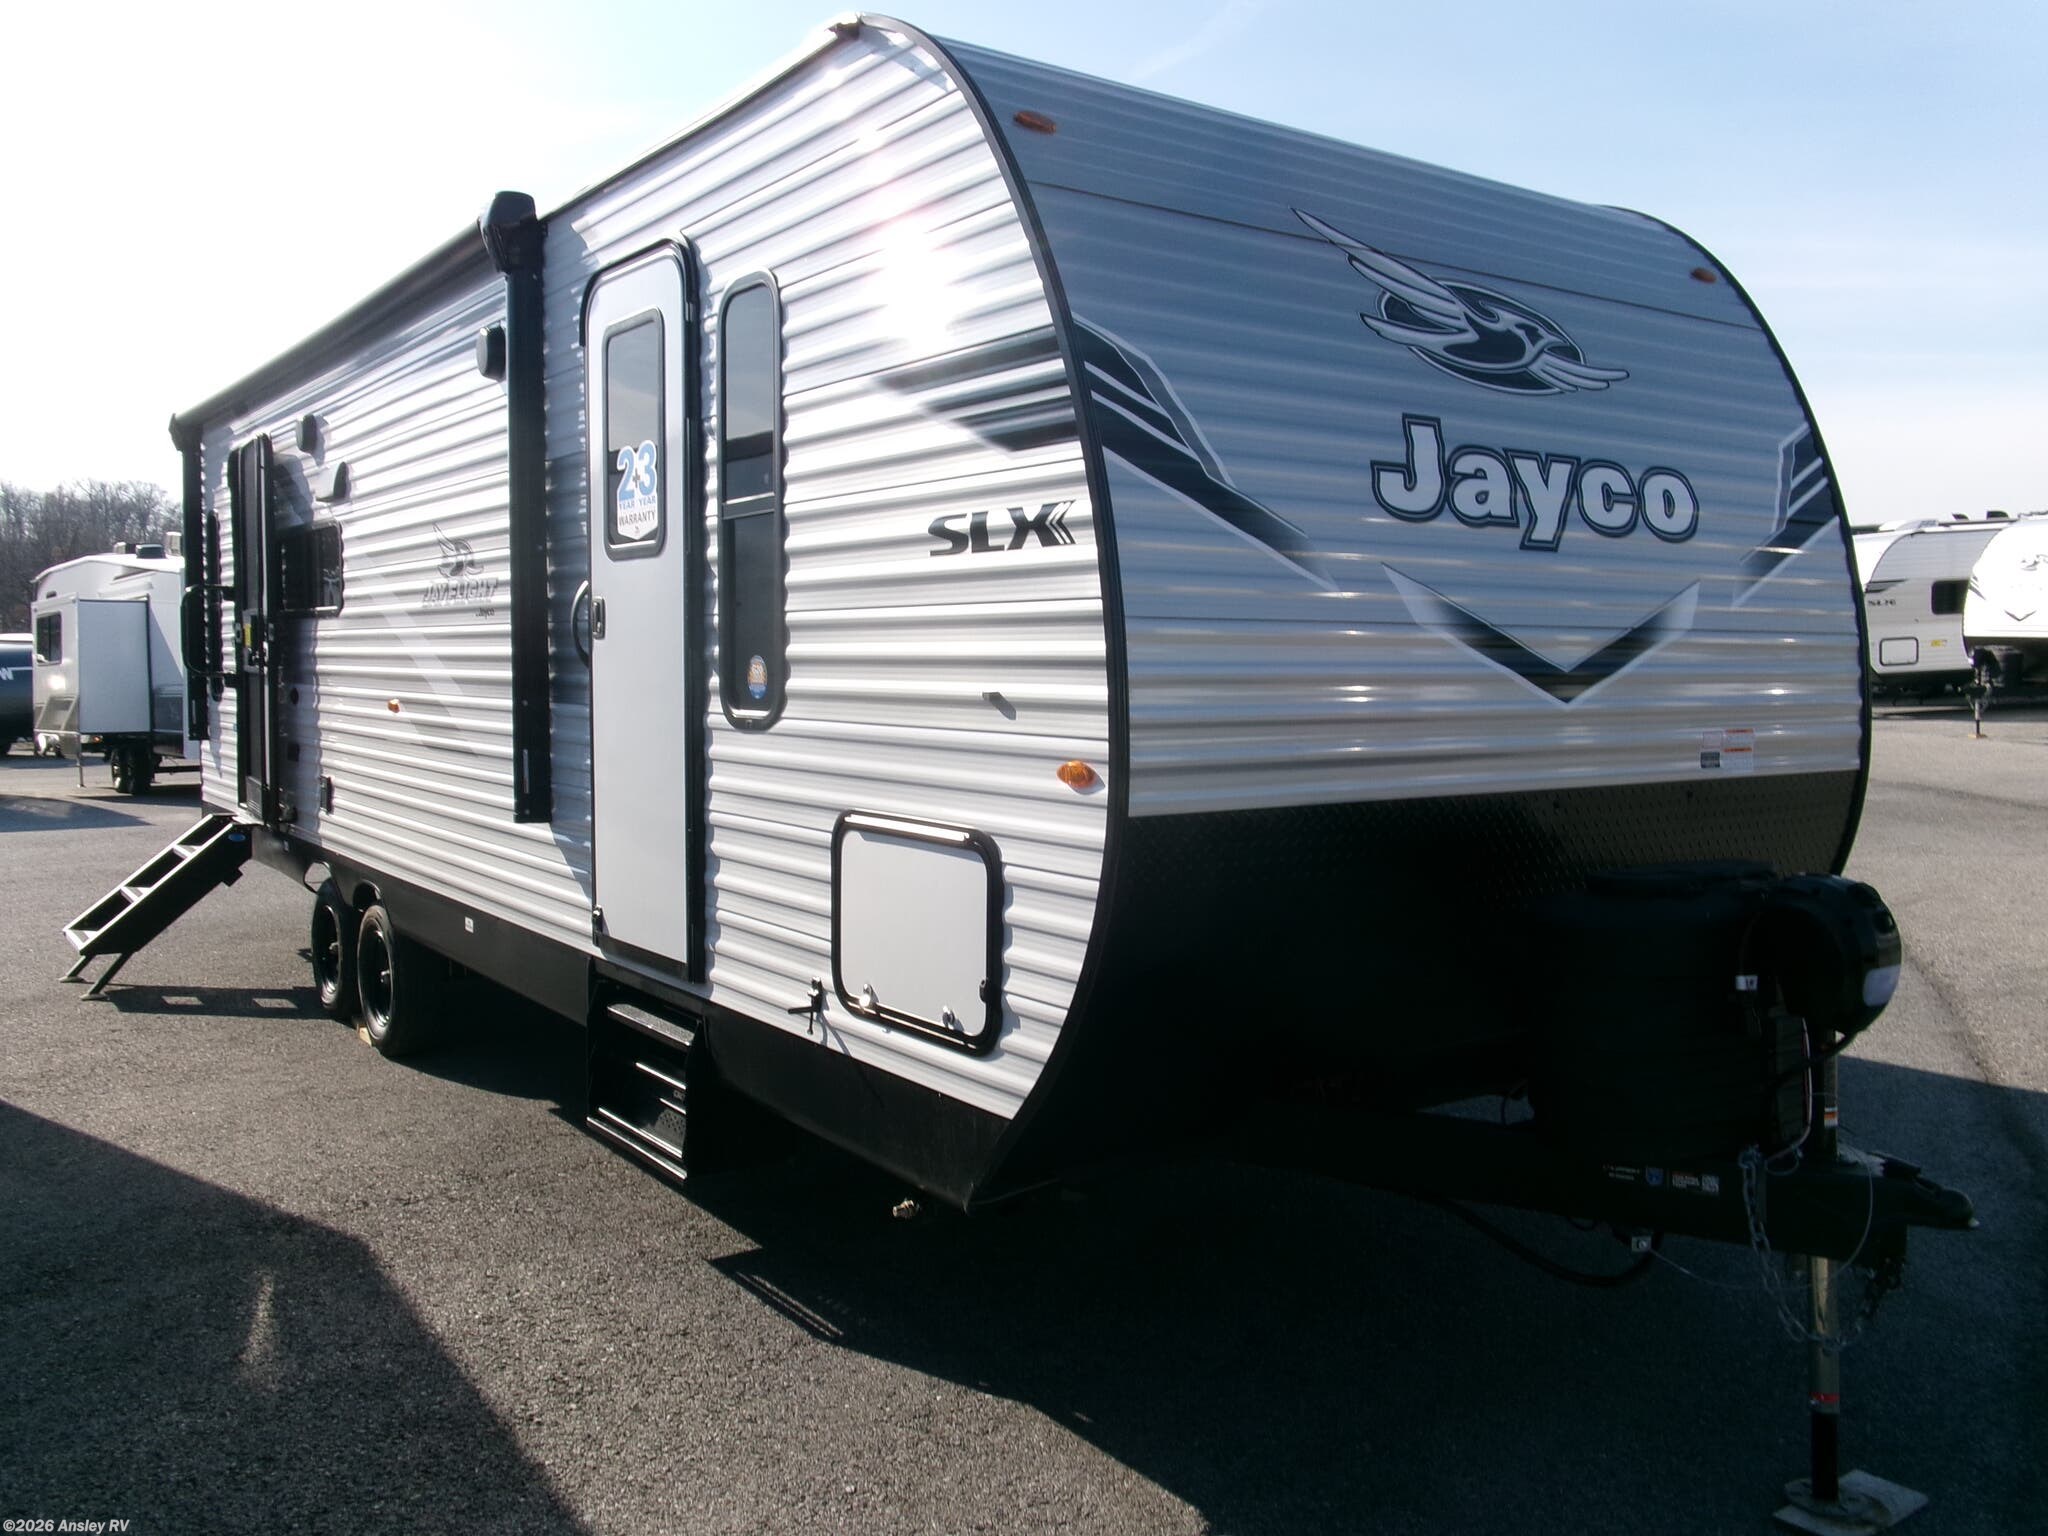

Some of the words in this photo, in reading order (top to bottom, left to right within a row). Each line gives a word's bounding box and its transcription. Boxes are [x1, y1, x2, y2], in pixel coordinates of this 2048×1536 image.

[1370, 412, 1699, 552] Jayco
[619, 511, 656, 526] WARRANTY
[927, 499, 1076, 557] SLX
